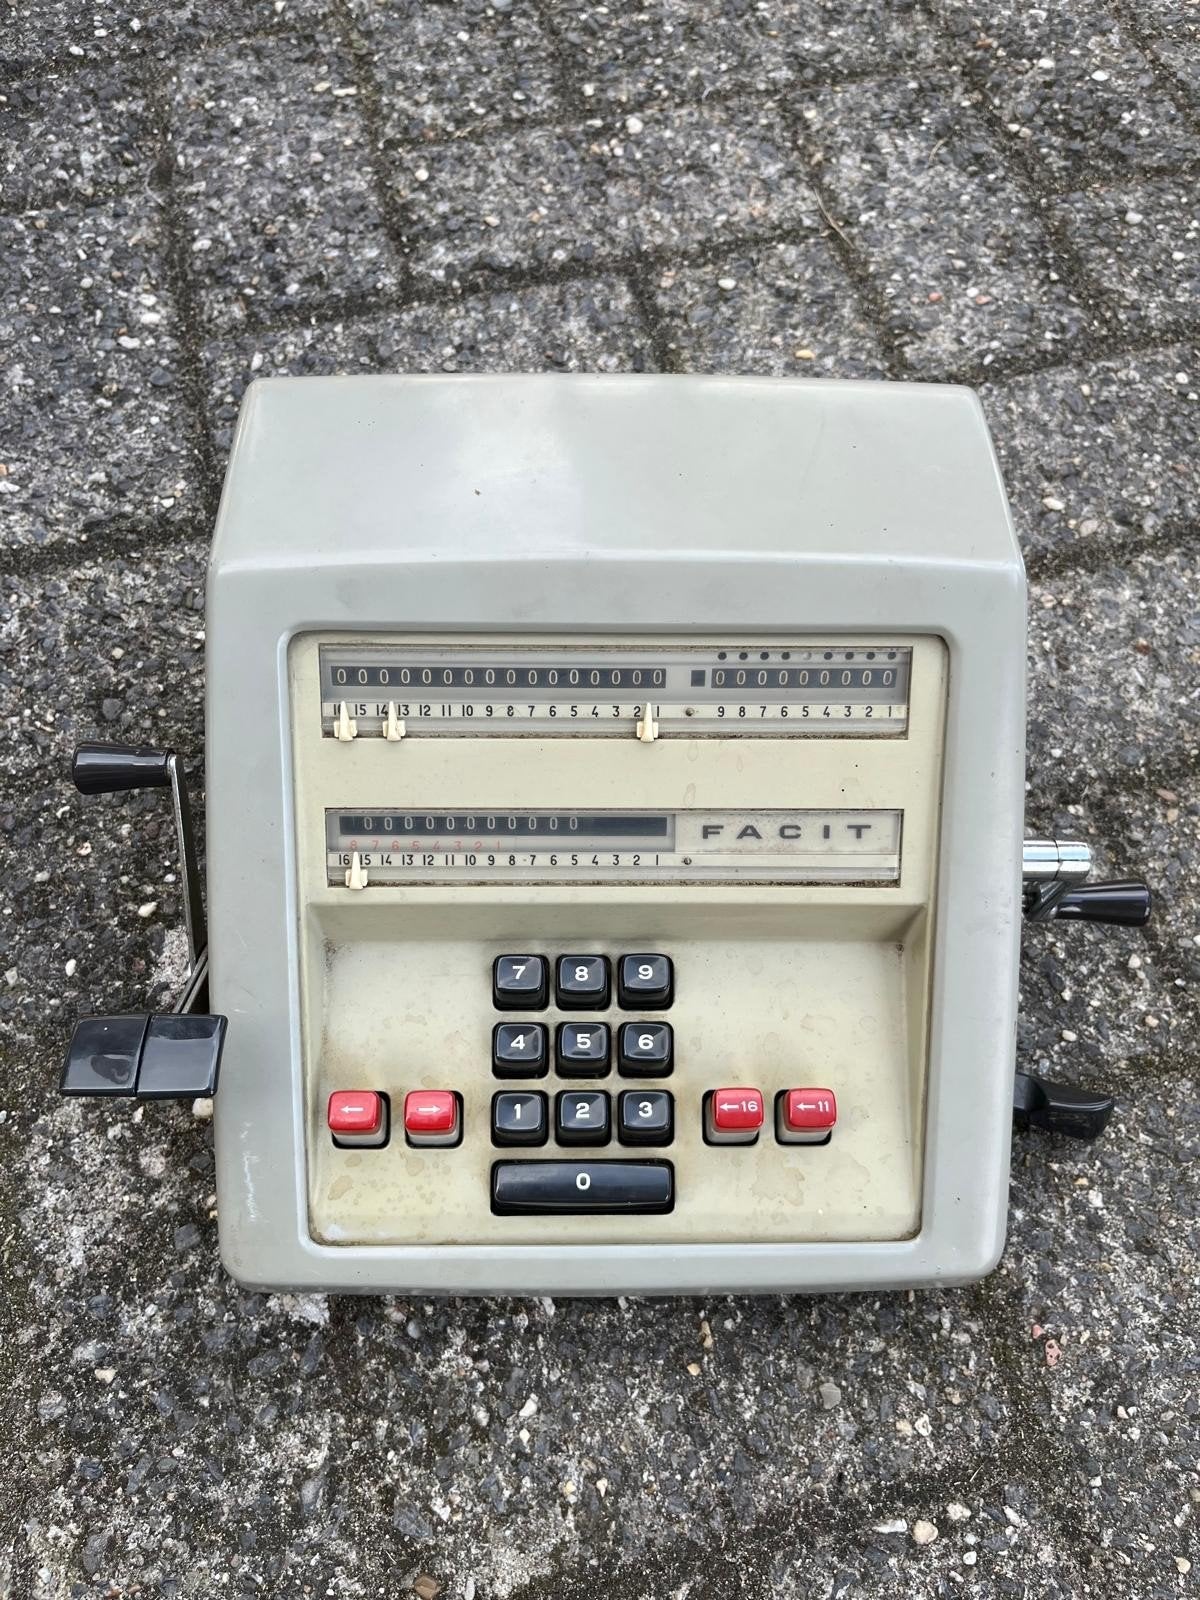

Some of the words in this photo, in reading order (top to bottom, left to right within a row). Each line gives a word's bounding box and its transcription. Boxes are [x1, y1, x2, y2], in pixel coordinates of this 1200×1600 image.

[355, 704, 366, 715] 15
[376, 704, 388, 716] 14
[398, 704, 410, 716] 13
[420, 705, 431, 716] 12
[442, 705, 451, 716] 11
[462, 705, 473, 716] 10
[486, 705, 493, 716] 9
[507, 706, 514, 717] 8
[528, 706, 535, 717] 7
[550, 706, 556, 717] 6
[571, 706, 577, 717] 5
[592, 706, 598, 717] 4
[613, 706, 620, 717] 3
[634, 706, 641, 717] 2
[717, 706, 725, 717] 9
[738, 706, 746, 717] 8
[759, 706, 767, 717] 7
[780, 706, 788, 717] 6
[802, 706, 809, 717] 5
[823, 706, 830, 717] 4
[844, 706, 851, 717] 3
[865, 706, 872, 717] 2
[702, 825, 872, 840] FACIT
[339, 855, 350, 865] 16
[360, 855, 371, 865] 15
[381, 855, 392, 865] 14
[402, 855, 413, 865] 13
[423, 855, 434, 865] 12
[445, 855, 454, 865] 11
[466, 855, 476, 865] 10
[488, 855, 495, 865] 9
[509, 855, 516, 865] 8
[530, 855, 536, 865] 7
[550, 855, 557, 865] 6
[572, 855, 578, 865] 5
[592, 855, 598, 865] 4
[613, 855, 619, 865] 3
[633, 855, 640, 865] 2
[512, 966, 526, 979] 7
[575, 966, 588, 980] 8
[638, 965, 653, 979] 9
[511, 1035, 525, 1049] 4
[577, 1034, 591, 1048] 5
[639, 1035, 653, 1049] 6
[514, 1104, 521, 1119] 1
[576, 1103, 590, 1118] 2
[639, 1102, 652, 1118] 3
[741, 1101, 758, 1112] 16
[818, 1101, 829, 1112] 11
[576, 1173, 591, 1189] 0
